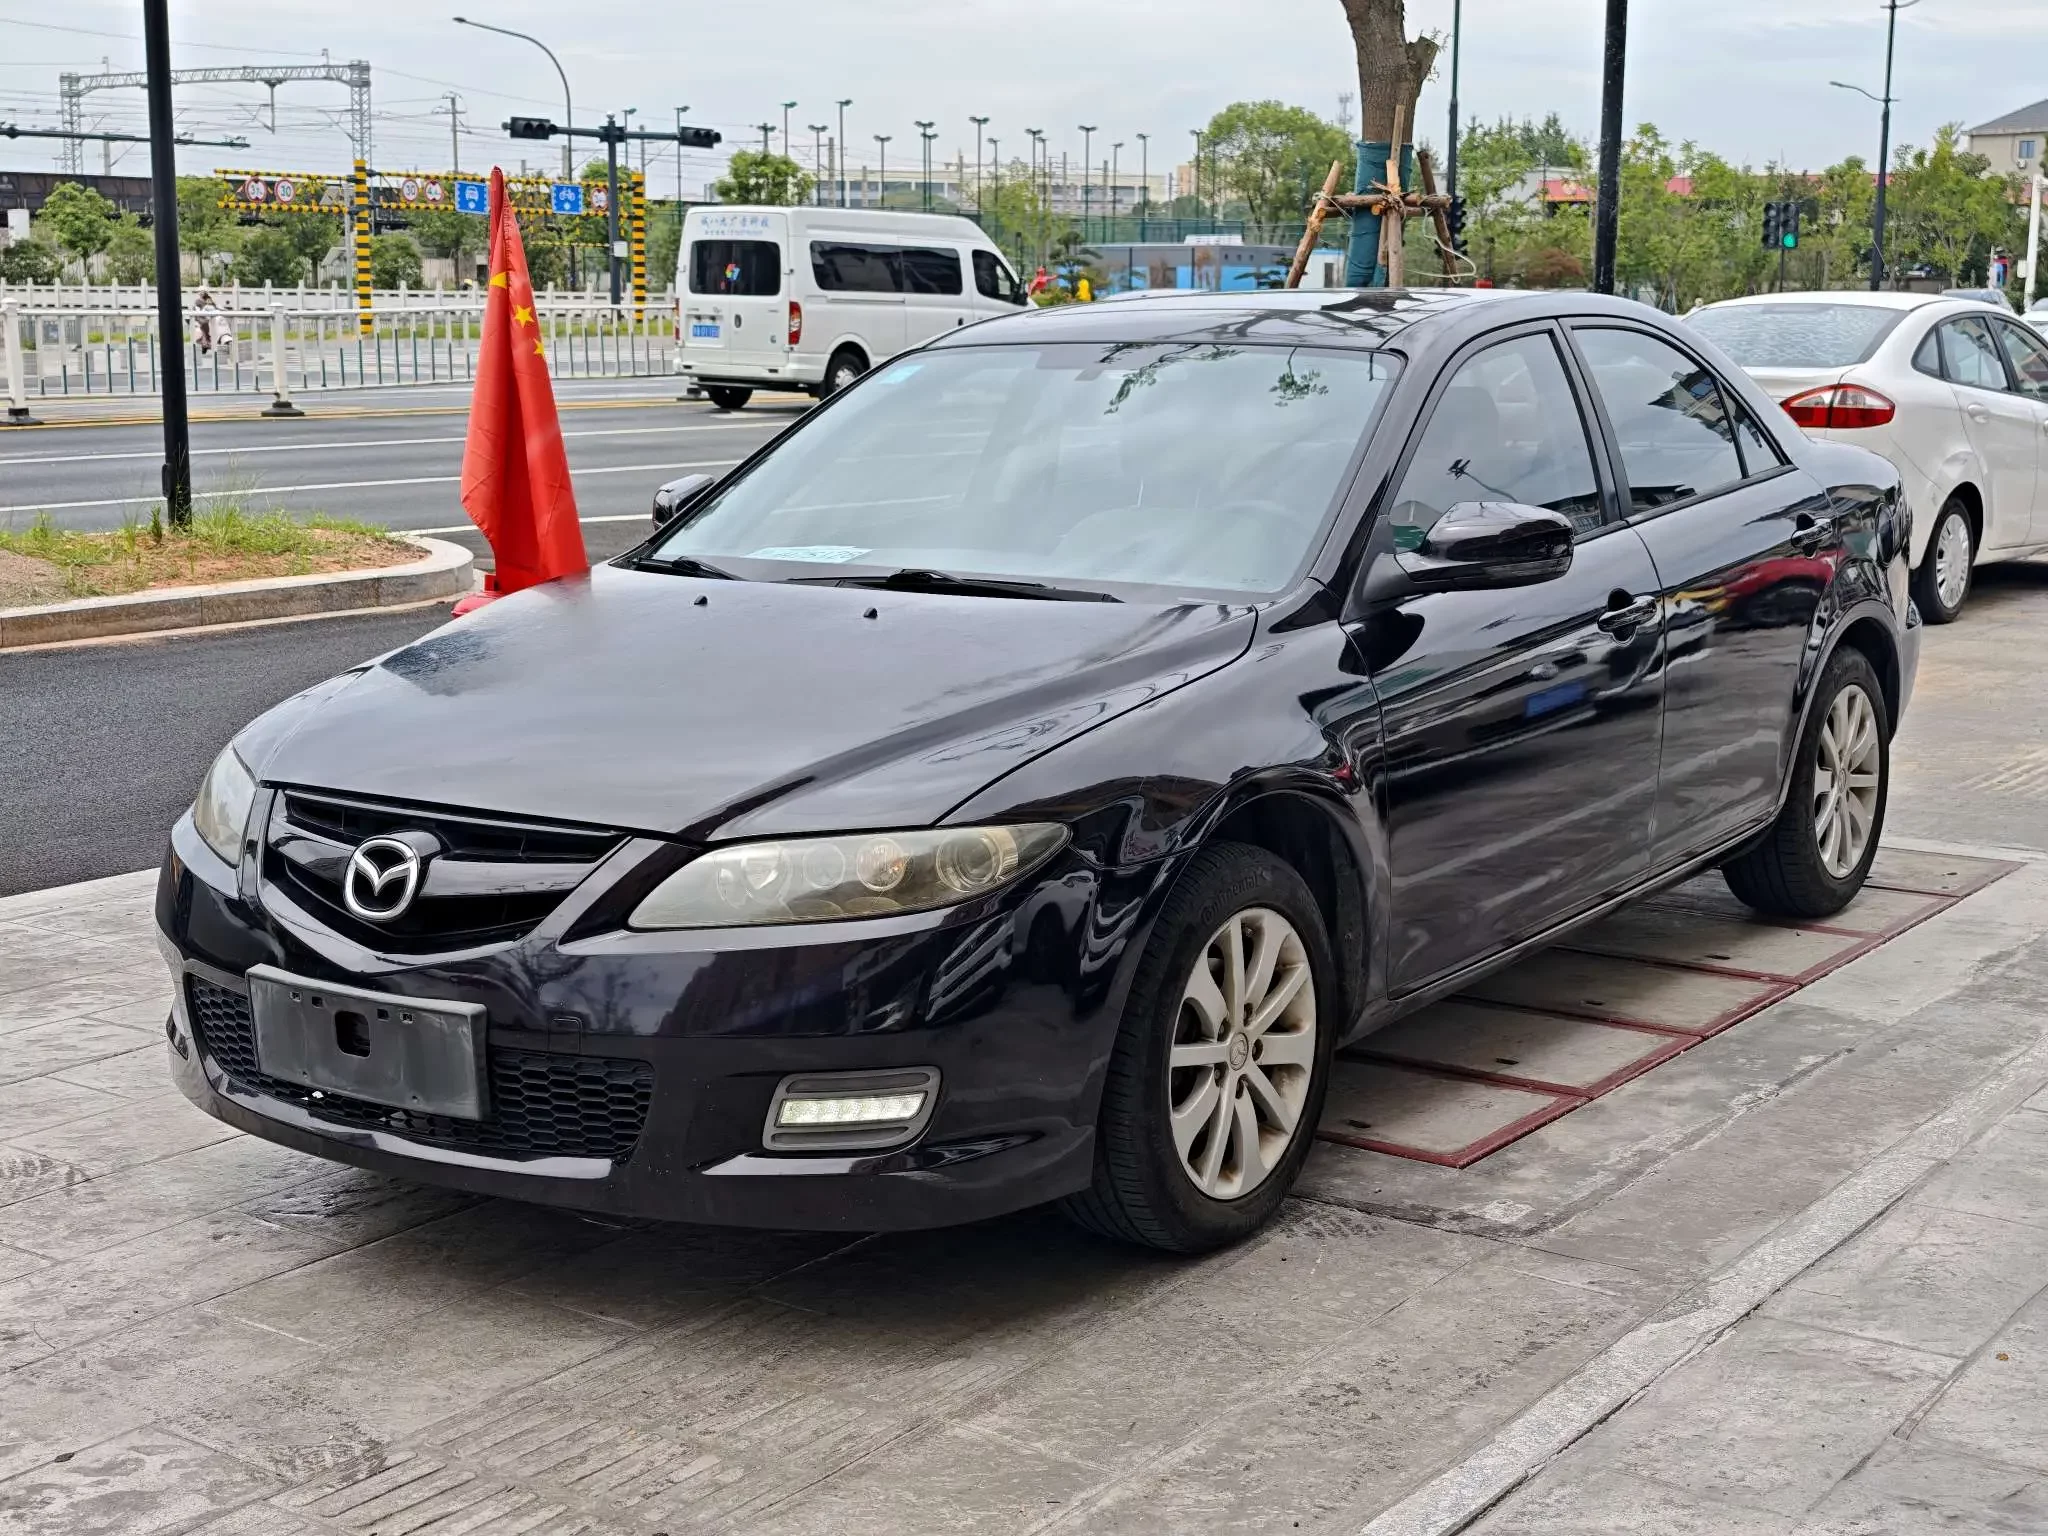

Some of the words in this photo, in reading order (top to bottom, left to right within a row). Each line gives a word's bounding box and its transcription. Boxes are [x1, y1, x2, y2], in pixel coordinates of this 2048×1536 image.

[280, 184, 292, 197] 30
[405, 184, 416, 196] 30
[1200, 871, 1259, 925] Continental
